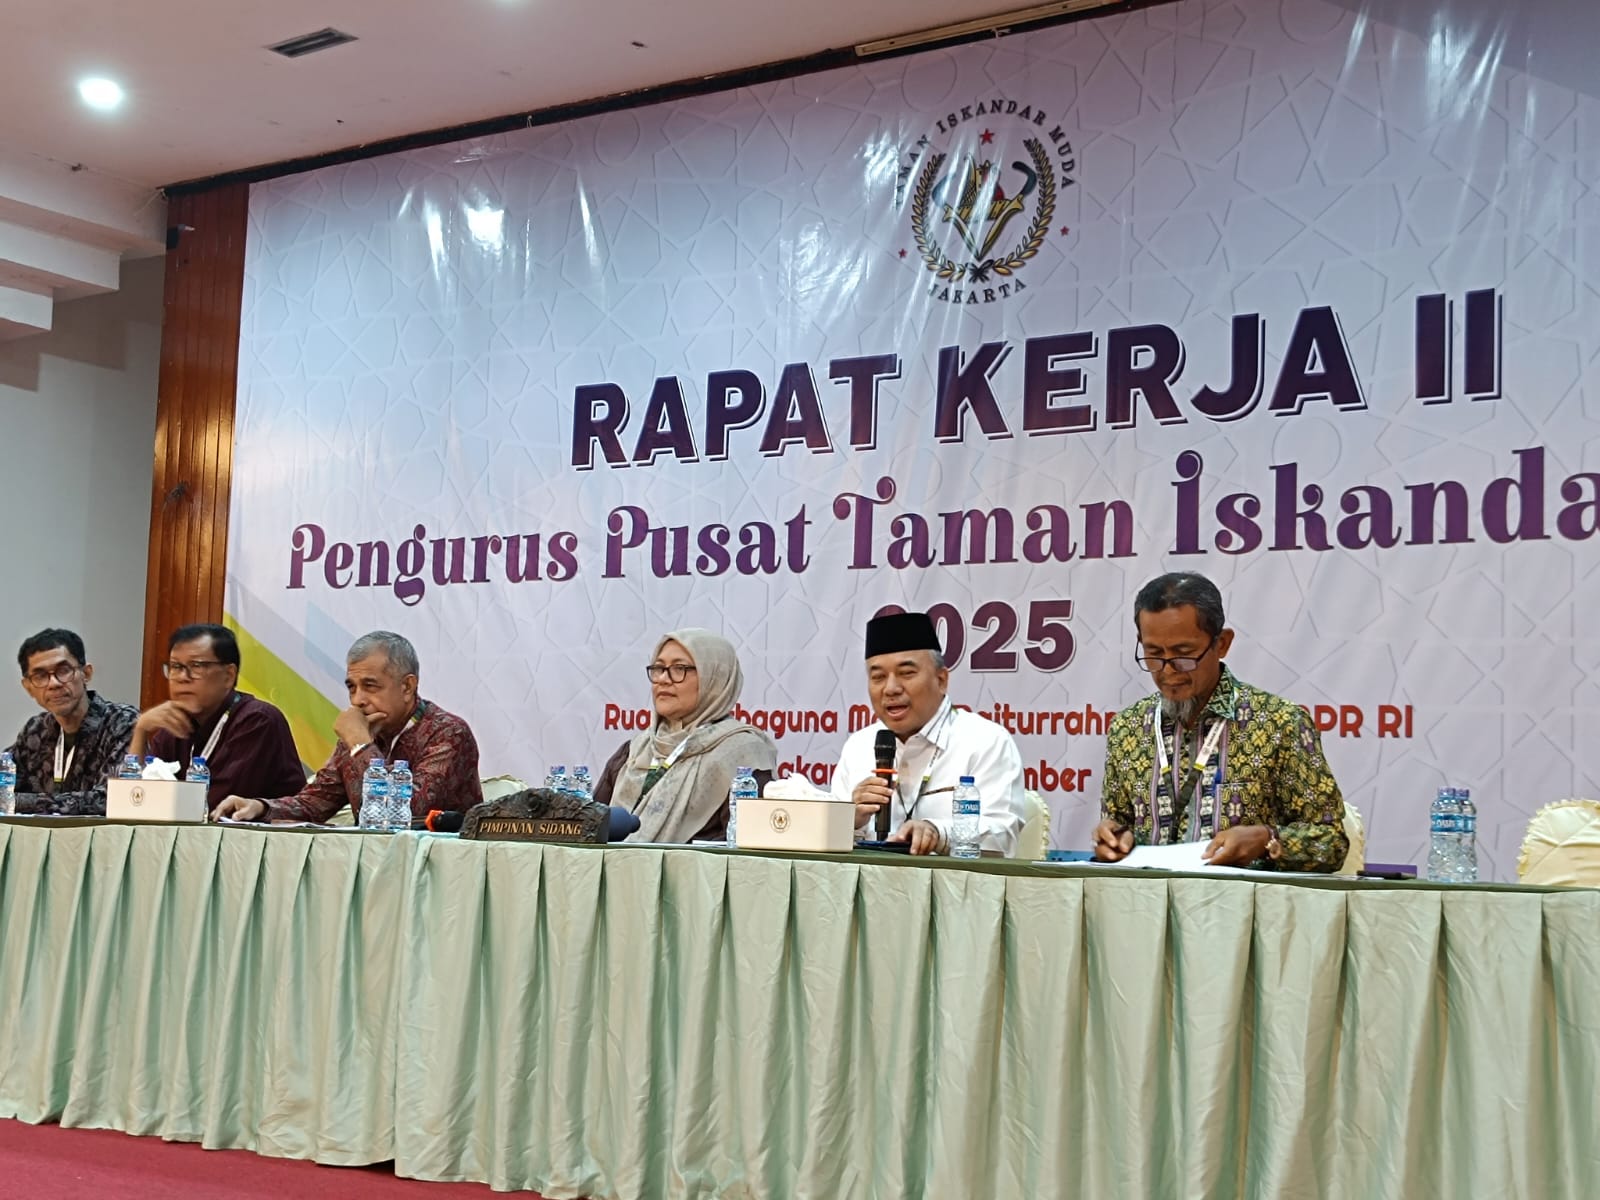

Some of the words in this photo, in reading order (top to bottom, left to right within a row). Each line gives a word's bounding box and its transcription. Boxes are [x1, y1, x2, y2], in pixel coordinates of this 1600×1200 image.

[936, 100, 1047, 134] ISKANDAR
[1048, 125, 1075, 190] MUDA
[928, 278, 1027, 305] JAKARTA
[571, 352, 902, 471] RAPAT
[933, 305, 1368, 443] KERJA
[1415, 288, 1502, 404] II
[286, 523, 579, 607] Pengurus
[601, 503, 811, 579] Pusat
[832, 475, 1138, 570] Taman
[604, 703, 651, 731] Rua
[730, 703, 838, 740] baguna
[1299, 704, 1363, 738] PR
[1378, 704, 1412, 738] RI
[479, 821, 535, 835] PIMPINAN
[538, 822, 583, 835] SIDANG
